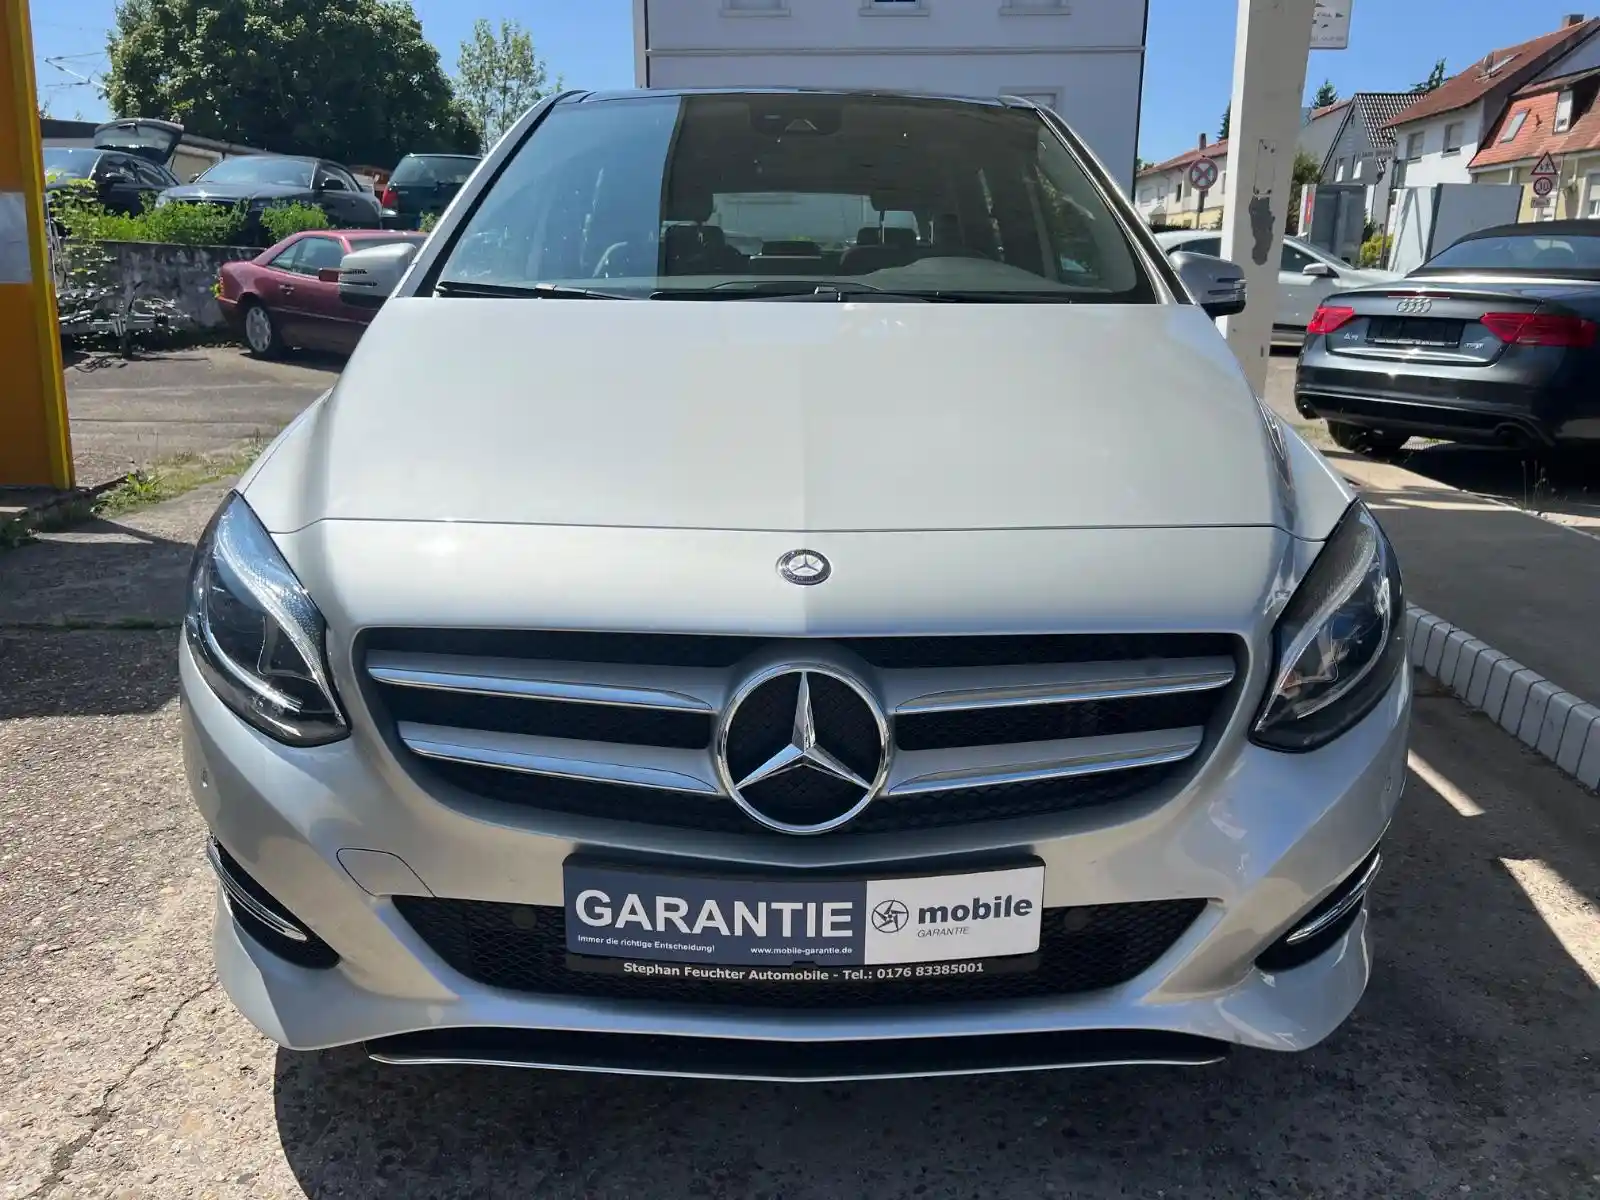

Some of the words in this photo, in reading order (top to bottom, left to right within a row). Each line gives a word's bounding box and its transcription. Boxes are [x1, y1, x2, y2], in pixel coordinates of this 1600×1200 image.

[575, 889, 853, 938] GARANTIE
[918, 895, 1033, 924] mobile
[917, 926, 970, 938] GARANTIE
[577, 935, 605, 944] Immer
[606, 937, 619, 945] die
[620, 938, 653, 949] richtige
[654, 941, 715, 953] Entscheidung!
[750, 946, 853, 956] www.mobile-garantie.de
[623, 962, 680, 977] Stephan
[684, 966, 746, 980] Feuchter
[748, 969, 829, 981] Automobile
[842, 970, 873, 980] Tel.:
[876, 967, 912, 979] 0176
[915, 963, 984, 977] 83385001
